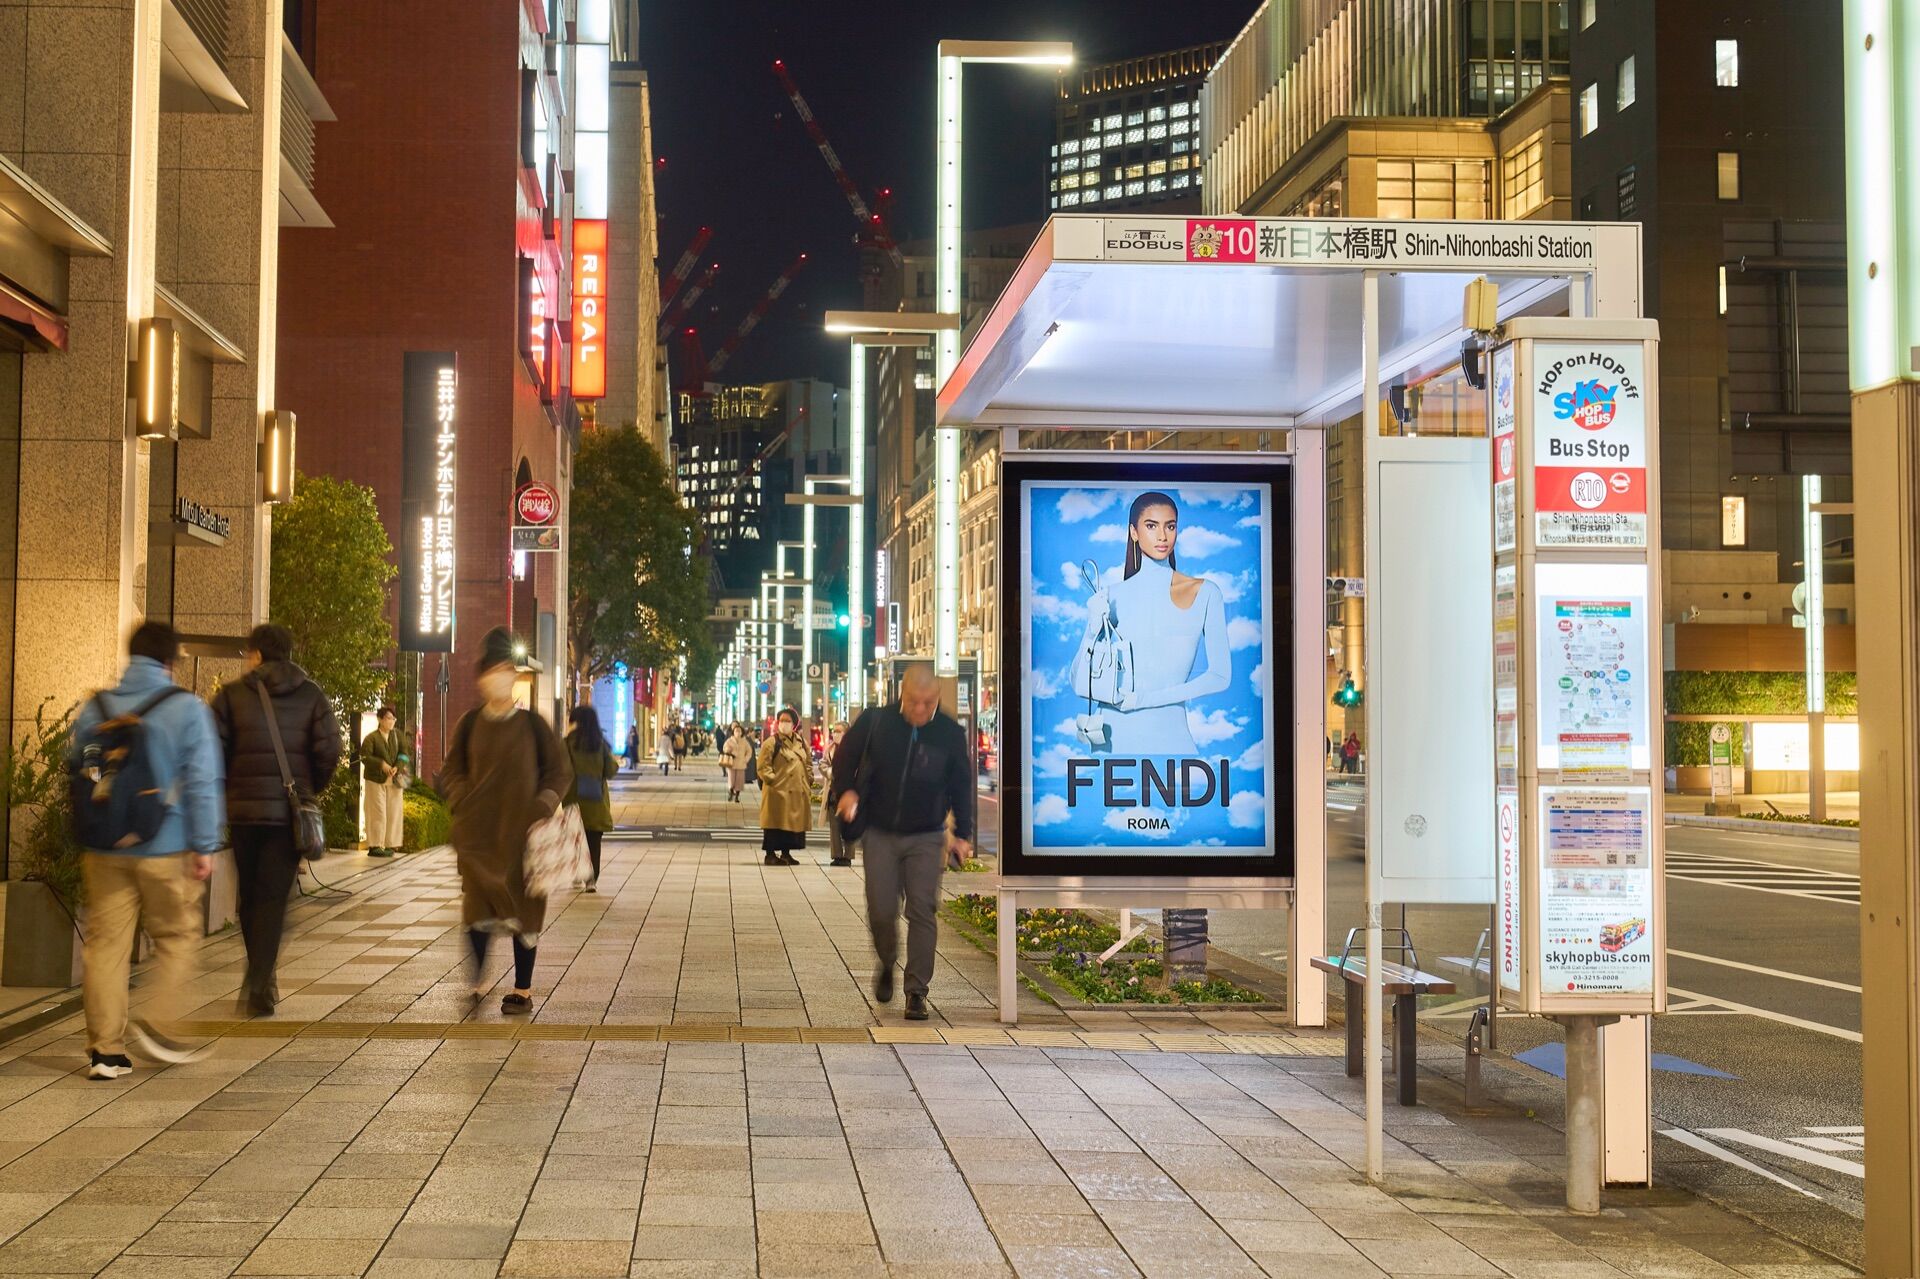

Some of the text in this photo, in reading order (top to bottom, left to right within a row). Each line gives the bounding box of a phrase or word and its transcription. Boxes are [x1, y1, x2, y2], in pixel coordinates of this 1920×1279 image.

[1107, 239, 1184, 250] EDOBUS
[1223, 226, 1254, 256] 10
[1259, 225, 1398, 260] 新日本橋駅
[1405, 232, 1592, 259] Shin-Nihonbashi Station
[581, 254, 598, 363] REGAL
[1538, 361, 1564, 396] HOP
[1566, 355, 1586, 368] on
[1589, 352, 1626, 376] HOP
[1621, 376, 1639, 399] off
[1575, 405, 1603, 418] HOP
[1585, 412, 1612, 427] BUS
[1549, 438, 1630, 463] Bus Stop
[436, 367, 455, 634] 三井ガーデンホテル日本橋プレミア
[1575, 478, 1604, 502] R10
[522, 498, 551, 513] 消火栓
[1067, 758, 1230, 808] FENDI
[1127, 818, 1170, 830] ROMA
[1504, 849, 1513, 973] NO SMOKING
[1545, 951, 1651, 965] skyhopbus.com
